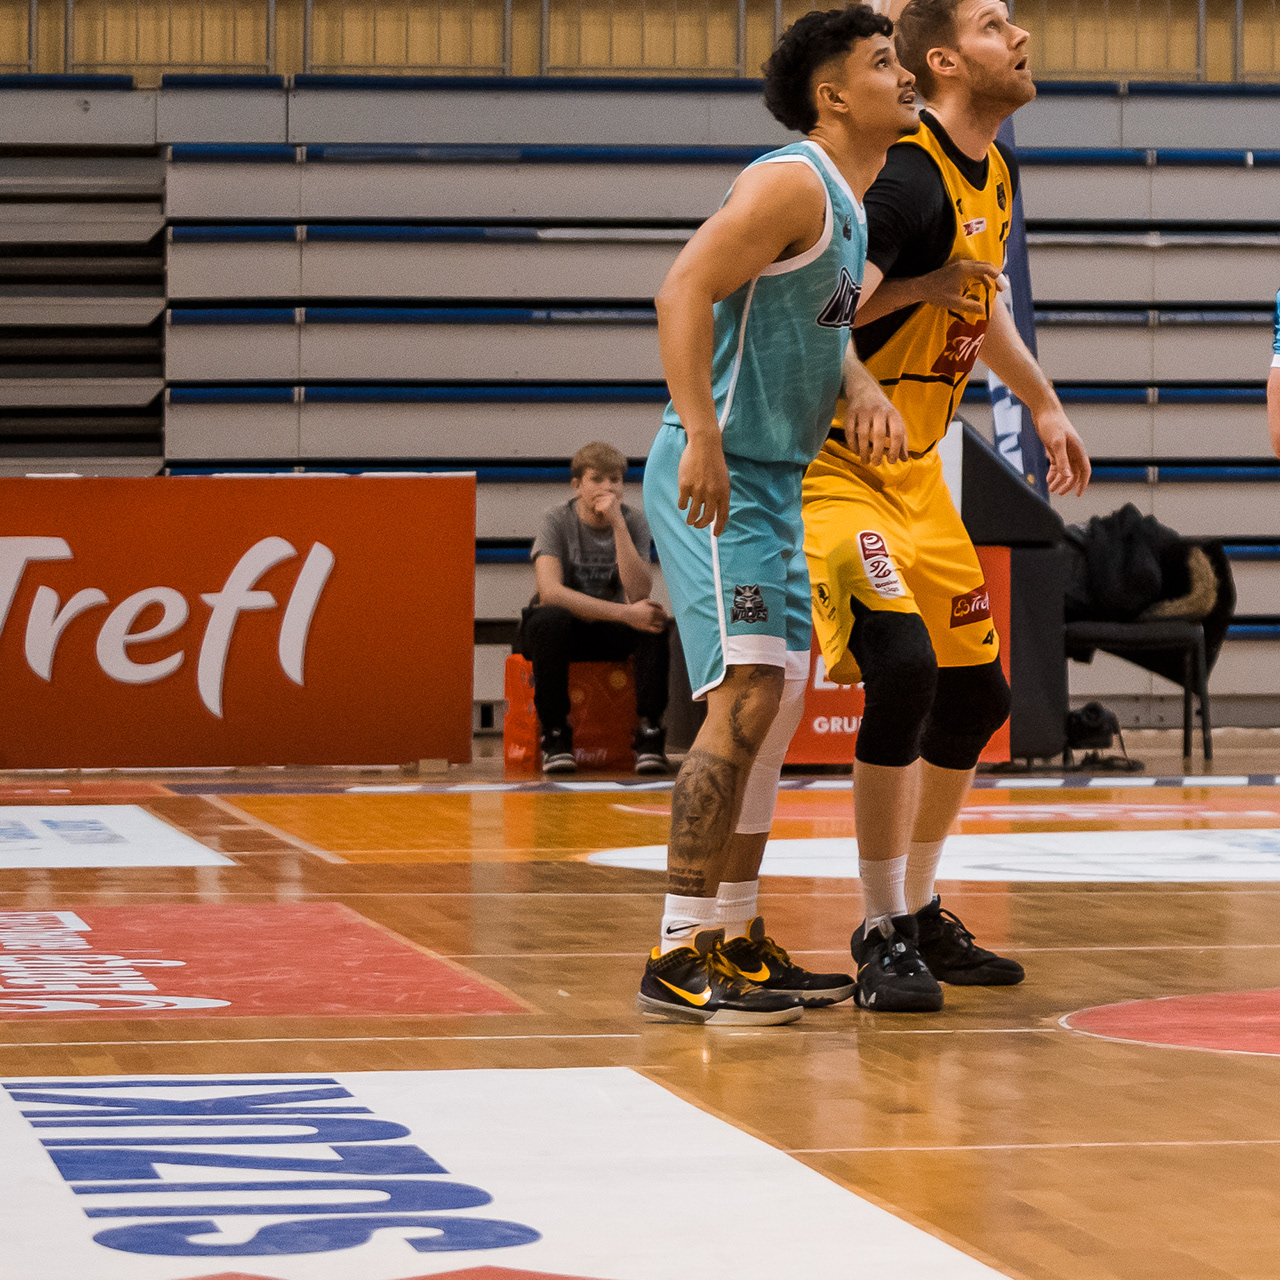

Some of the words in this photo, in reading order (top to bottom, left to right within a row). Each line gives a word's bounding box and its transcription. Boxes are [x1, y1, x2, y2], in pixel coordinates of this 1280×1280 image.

[0, 536, 335, 718] Trefl
[813, 716, 863, 734] GRU
[3, 1076, 543, 1257] SUZUKI
